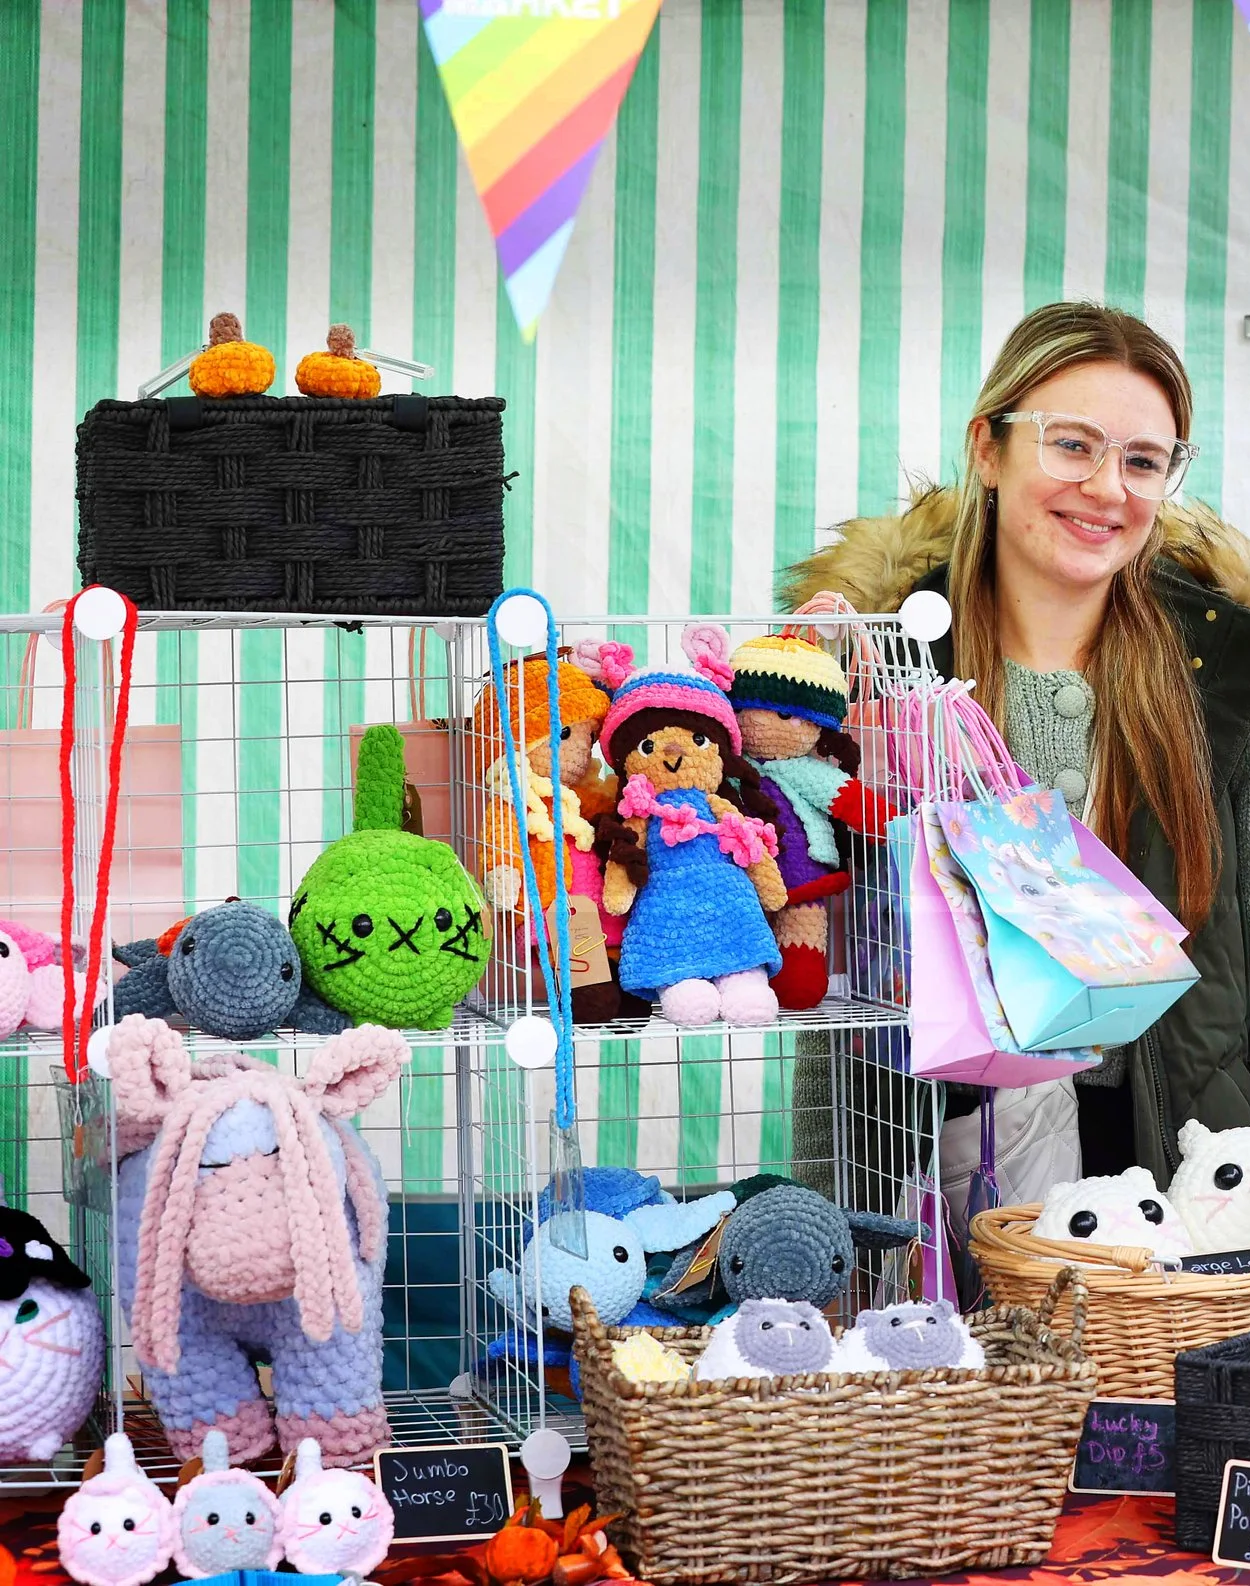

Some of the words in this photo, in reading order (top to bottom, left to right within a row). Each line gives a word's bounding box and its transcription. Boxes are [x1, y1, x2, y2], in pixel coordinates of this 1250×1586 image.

[1175, 1261, 1232, 1275] arge
[1091, 1411, 1158, 1441] Lucky
[1088, 1441, 1126, 1466] Dip
[1132, 1442, 1165, 1473] £5
[393, 1459, 468, 1482] Jumbo
[393, 1488, 456, 1507] Horse
[466, 1491, 504, 1526] £30
